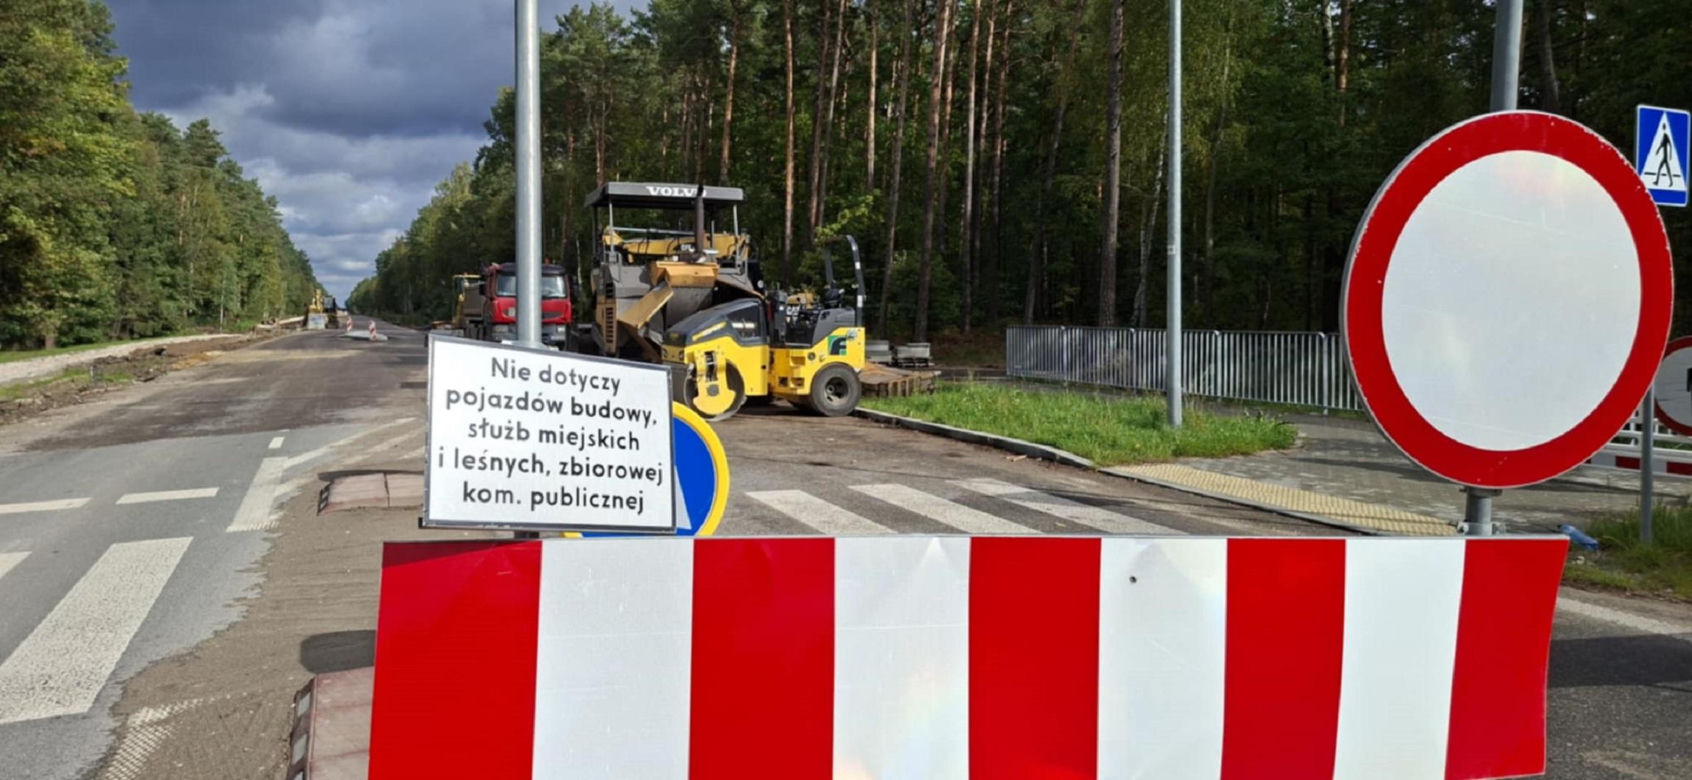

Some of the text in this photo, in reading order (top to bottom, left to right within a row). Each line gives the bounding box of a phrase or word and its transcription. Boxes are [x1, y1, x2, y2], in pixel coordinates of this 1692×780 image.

[491, 357, 619, 396] Nie dotyczy
[446, 388, 657, 428] pojazdów budowy,
[467, 418, 640, 451] służb miejskich
[438, 446, 663, 486] i leśnych, zbiorowej
[463, 481, 644, 515] kom. publicznej
